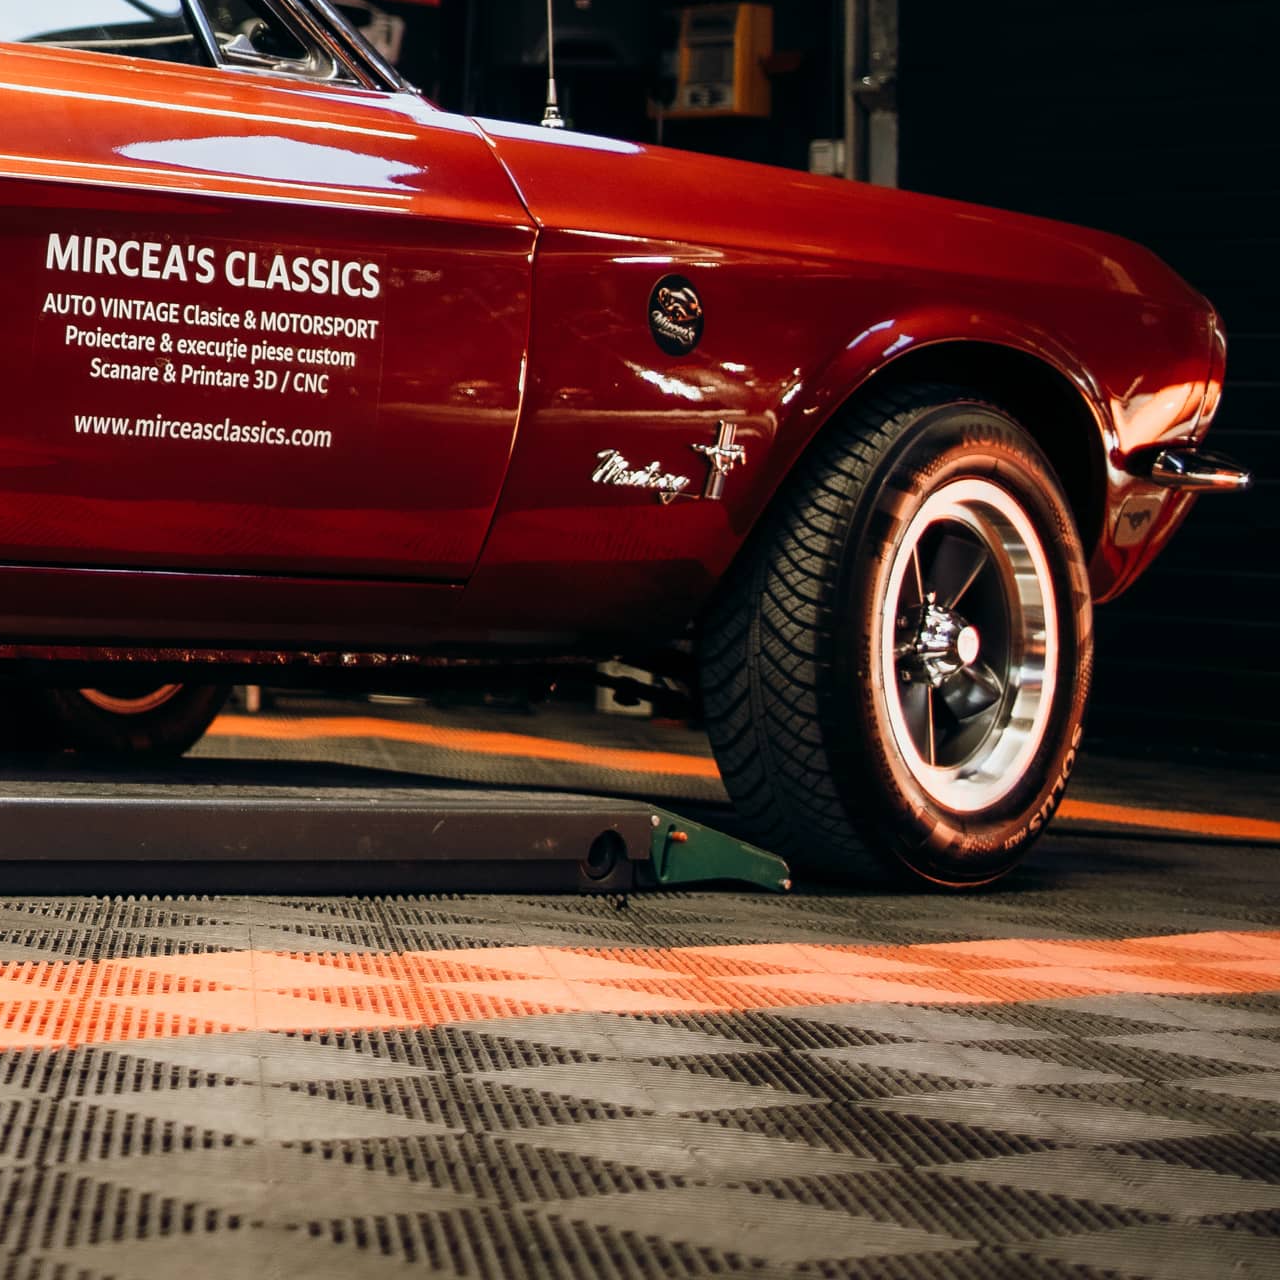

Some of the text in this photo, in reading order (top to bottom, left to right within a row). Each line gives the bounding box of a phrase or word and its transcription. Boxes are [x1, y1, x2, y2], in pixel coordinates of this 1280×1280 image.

[45, 232, 381, 298] MIRCEA'S CLASSICS
[42, 292, 379, 340] AUTO VINTAGE Clasice & MOTORSPORT
[65, 325, 155, 352] Proiectare
[159, 332, 173, 353] &
[251, 341, 294, 365] piese
[297, 347, 356, 367] custom
[90, 357, 159, 383] Scanare
[163, 362, 177, 384] &
[180, 364, 249, 389] Printare
[253, 369, 278, 390] 3D
[292, 372, 329, 394] CNC
[74, 413, 332, 448] www.mirceasclassics.com
